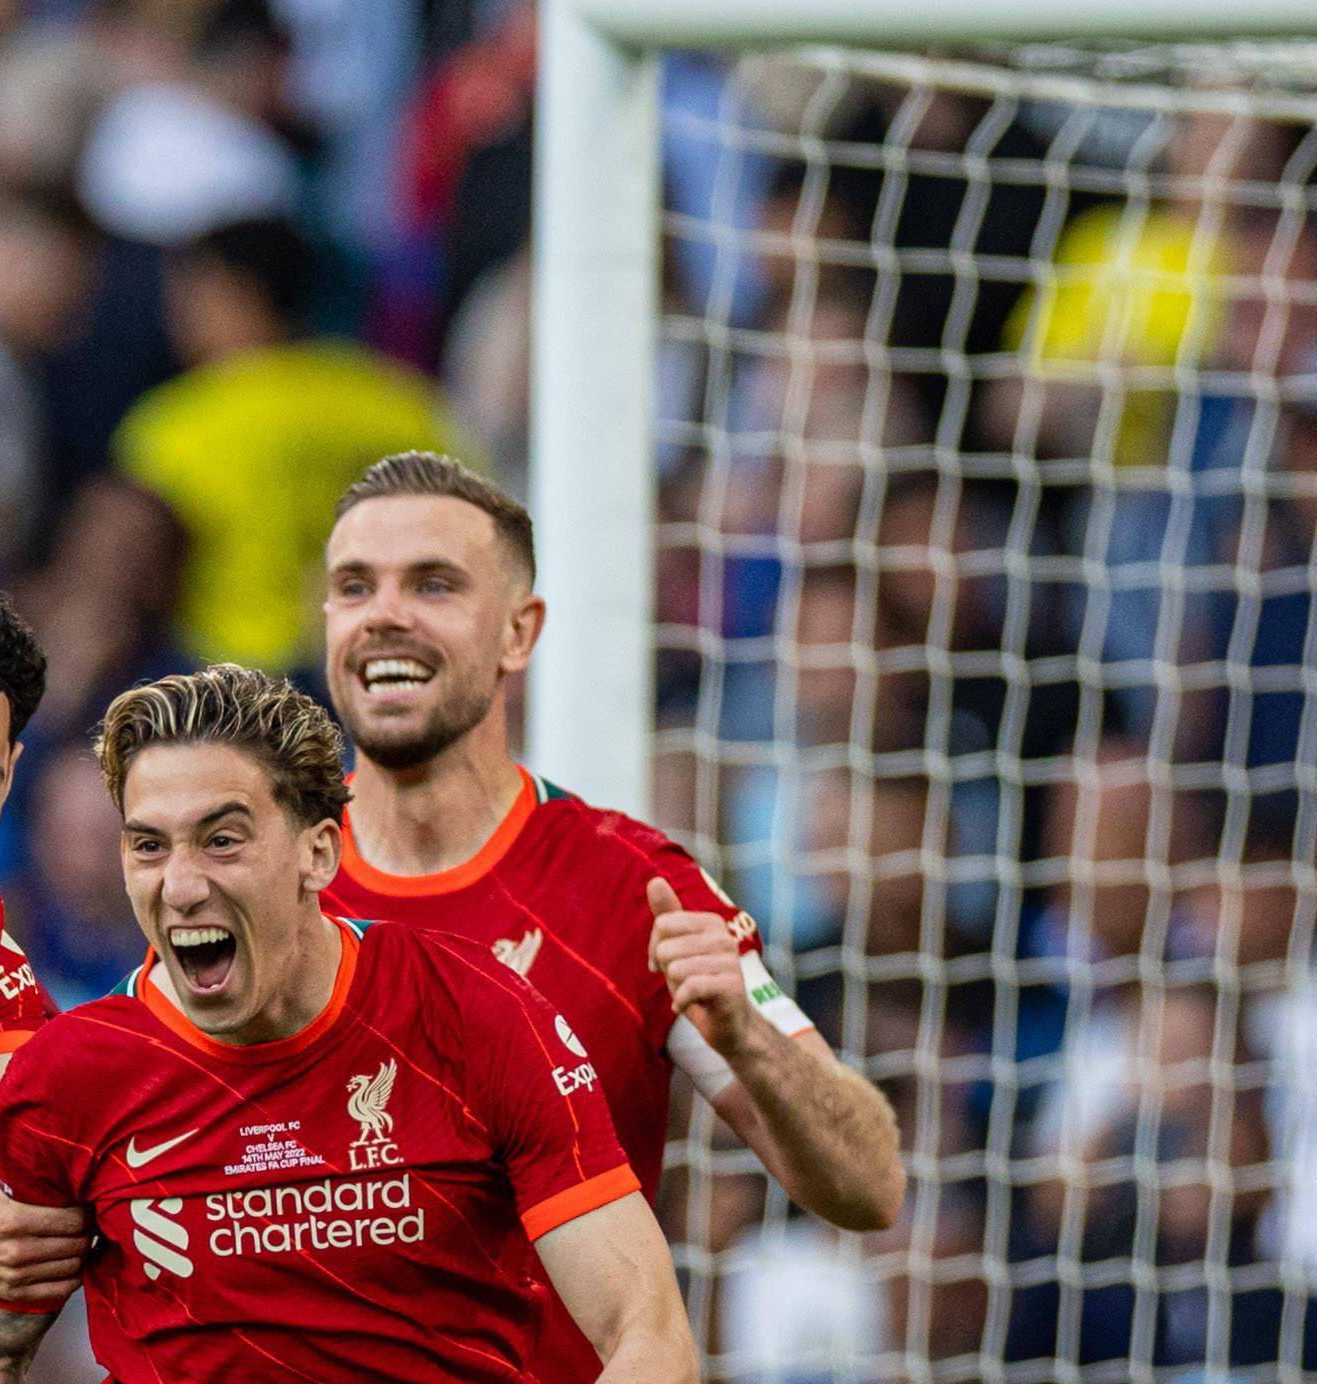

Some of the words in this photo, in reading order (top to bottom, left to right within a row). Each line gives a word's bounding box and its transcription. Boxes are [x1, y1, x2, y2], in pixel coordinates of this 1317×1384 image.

[240, 1123, 287, 1137] LIVERPOOL
[288, 1121, 300, 1131] FC
[267, 1133, 275, 1142] V
[245, 1141, 284, 1154] CHELSEA
[285, 1140, 297, 1149] FC
[241, 1153, 264, 1164] 14TH
[264, 1151, 284, 1161] MAY
[285, 1148, 306, 1159] 2022
[224, 1162, 268, 1175] EMIRATES
[268, 1161, 280, 1170] FA
[281, 1158, 299, 1168] CUP
[299, 1155, 325, 1166] FINAL
[206, 1173, 410, 1221] standard
[209, 1208, 424, 1256] chartered
